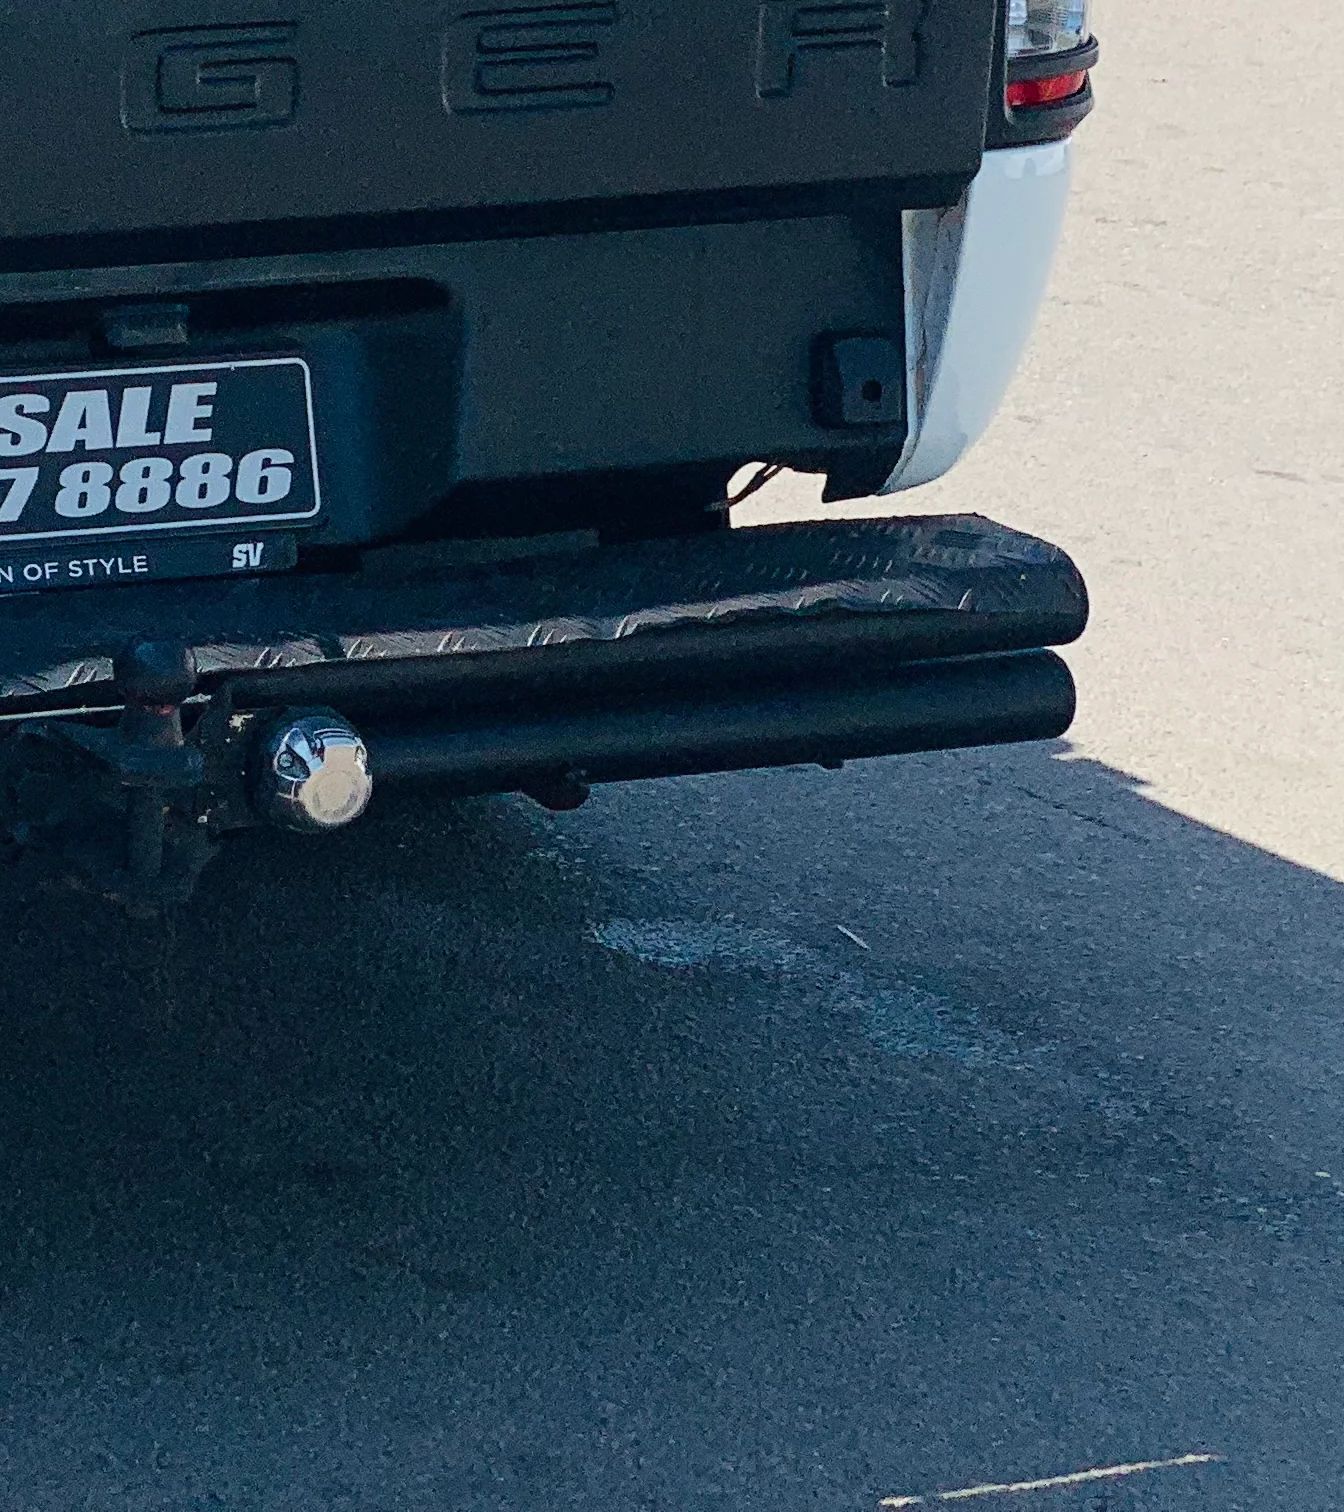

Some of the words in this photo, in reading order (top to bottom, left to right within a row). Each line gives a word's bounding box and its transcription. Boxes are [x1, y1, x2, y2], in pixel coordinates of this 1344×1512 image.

[55, 448, 295, 518] 8886
[23, 560, 60, 582] OF
[68, 554, 150, 579] STYLE
[232, 541, 265, 569] SV
